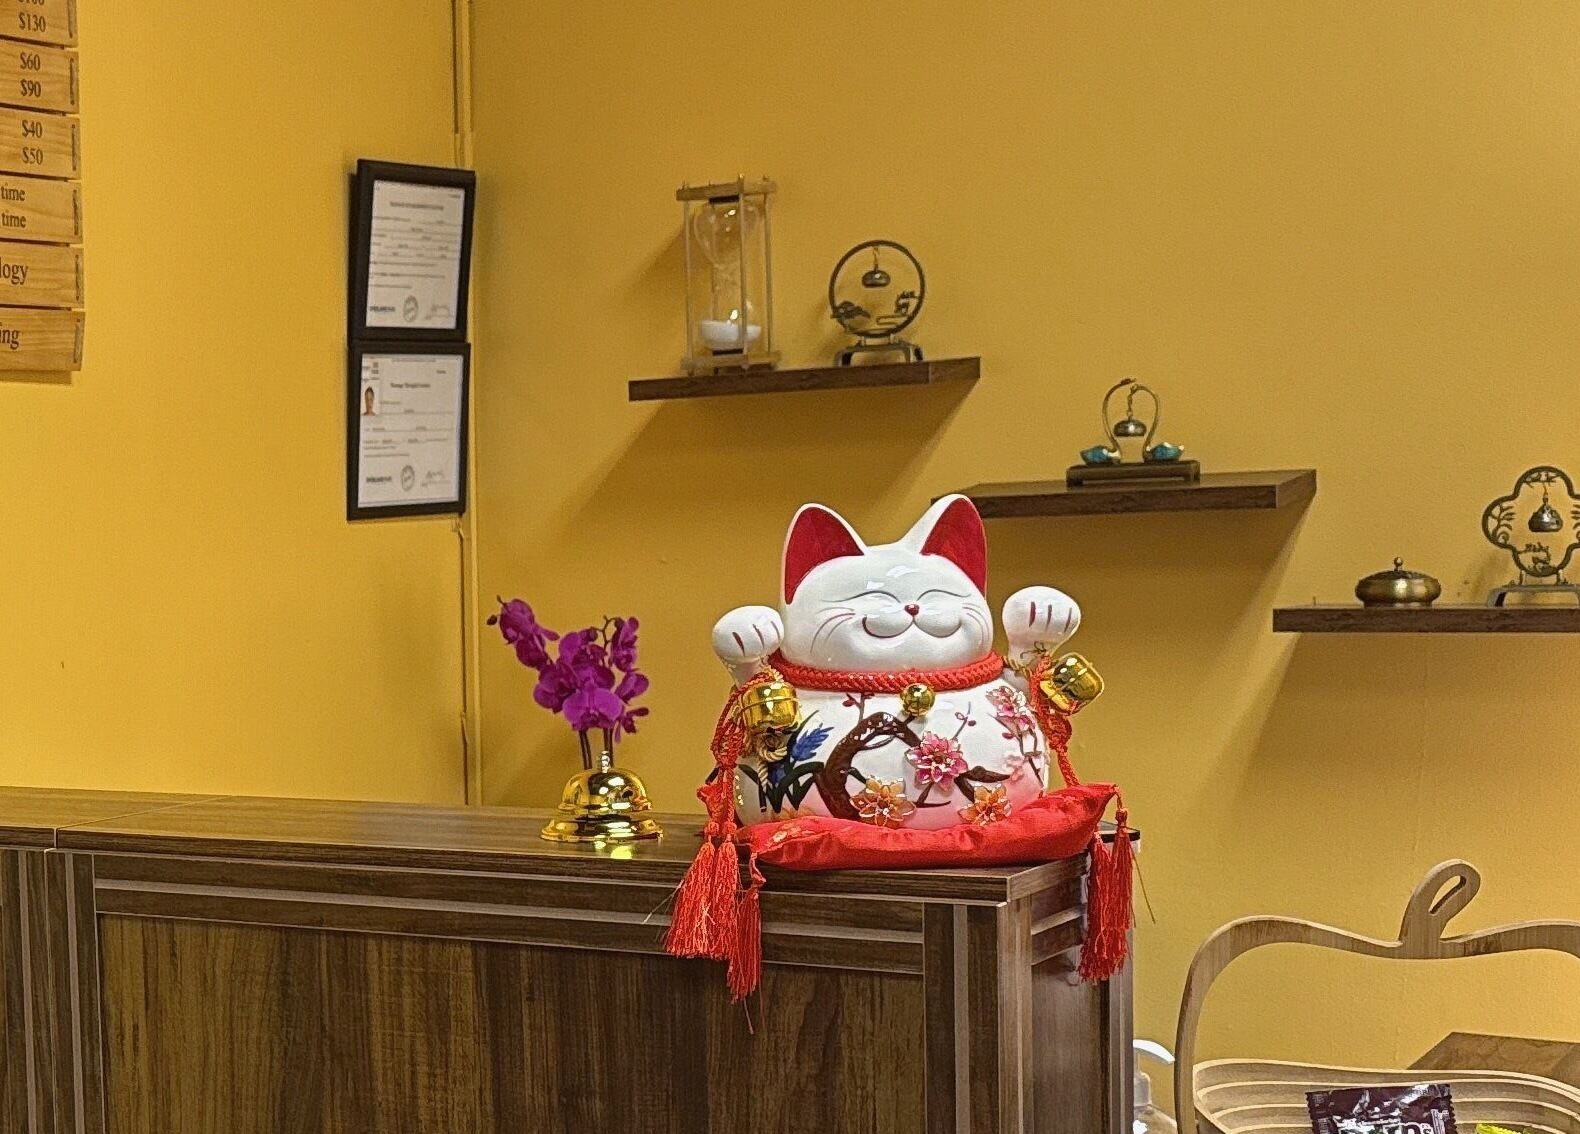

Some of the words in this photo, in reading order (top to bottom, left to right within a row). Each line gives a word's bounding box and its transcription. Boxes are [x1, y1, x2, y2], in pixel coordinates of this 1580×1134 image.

[19, 11, 46, 32] $130
[20, 53, 40, 70] $60
[21, 79, 42, 98] $90
[22, 122, 43, 139] $40
[22, 149, 44, 165] $50
[0, 183, 26, 201] time
[1, 210, 27, 227] time
